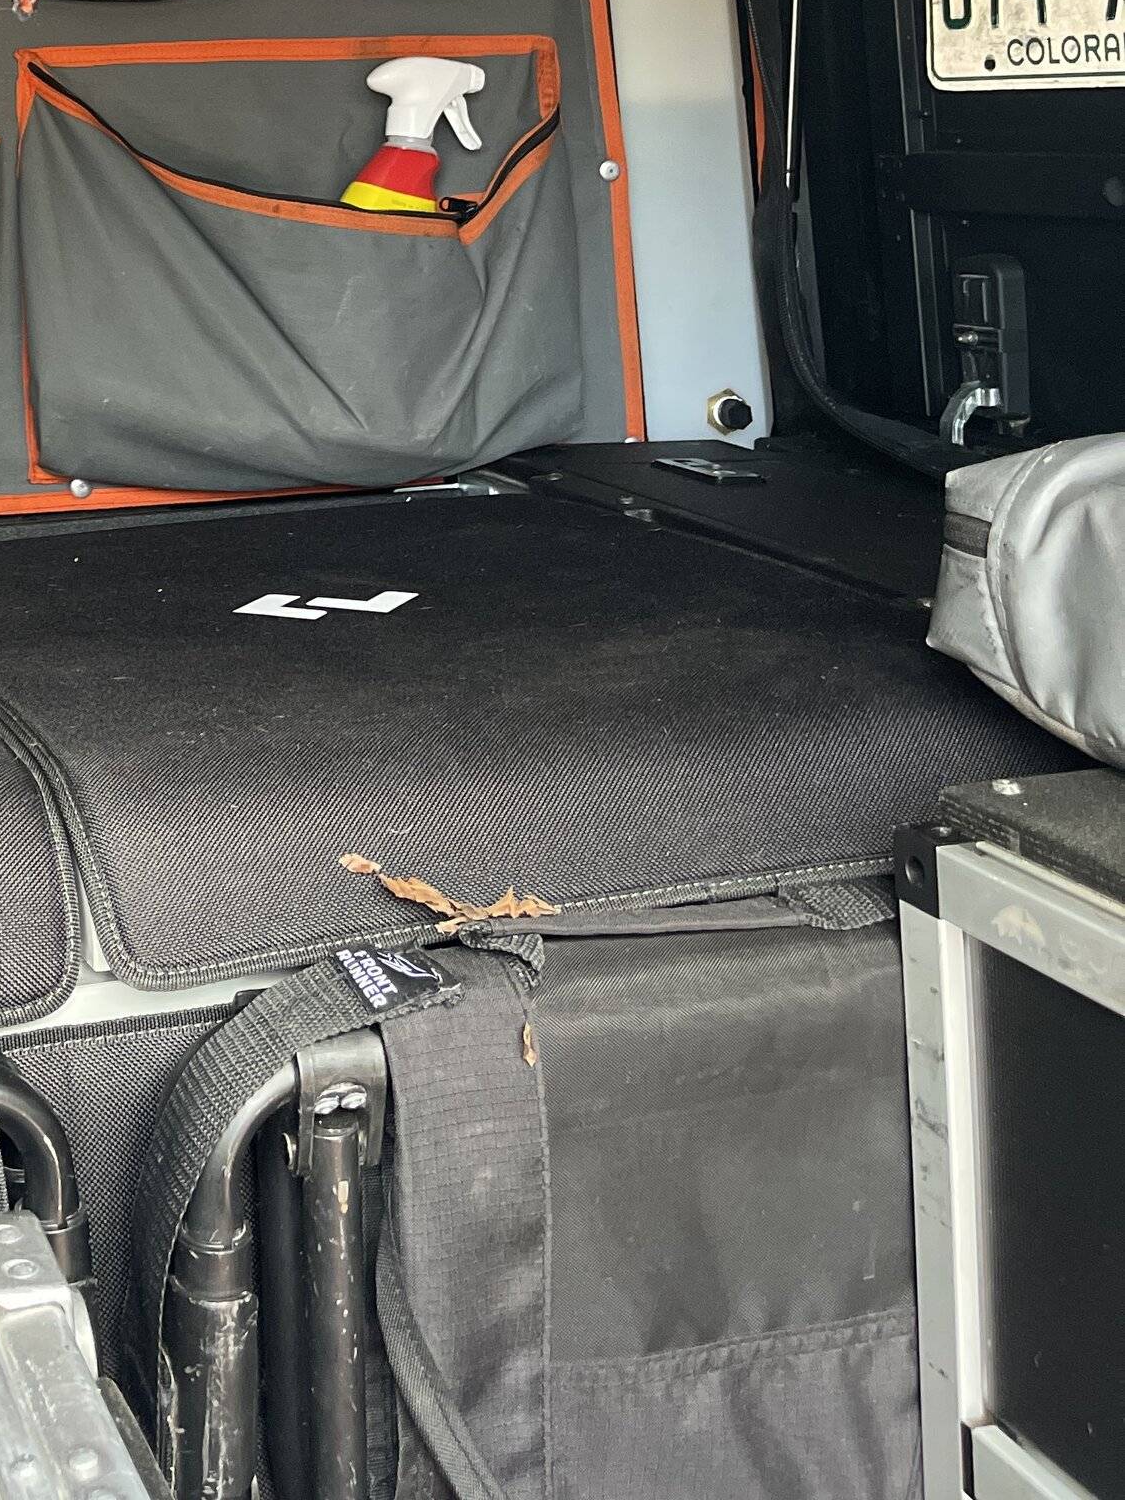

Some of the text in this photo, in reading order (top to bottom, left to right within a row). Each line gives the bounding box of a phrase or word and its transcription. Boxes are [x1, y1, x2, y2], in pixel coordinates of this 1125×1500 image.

[1007, 32, 1125, 66] COLORA
[336, 949, 386, 1008] RUNNER
[353, 949, 399, 995] FRONT
